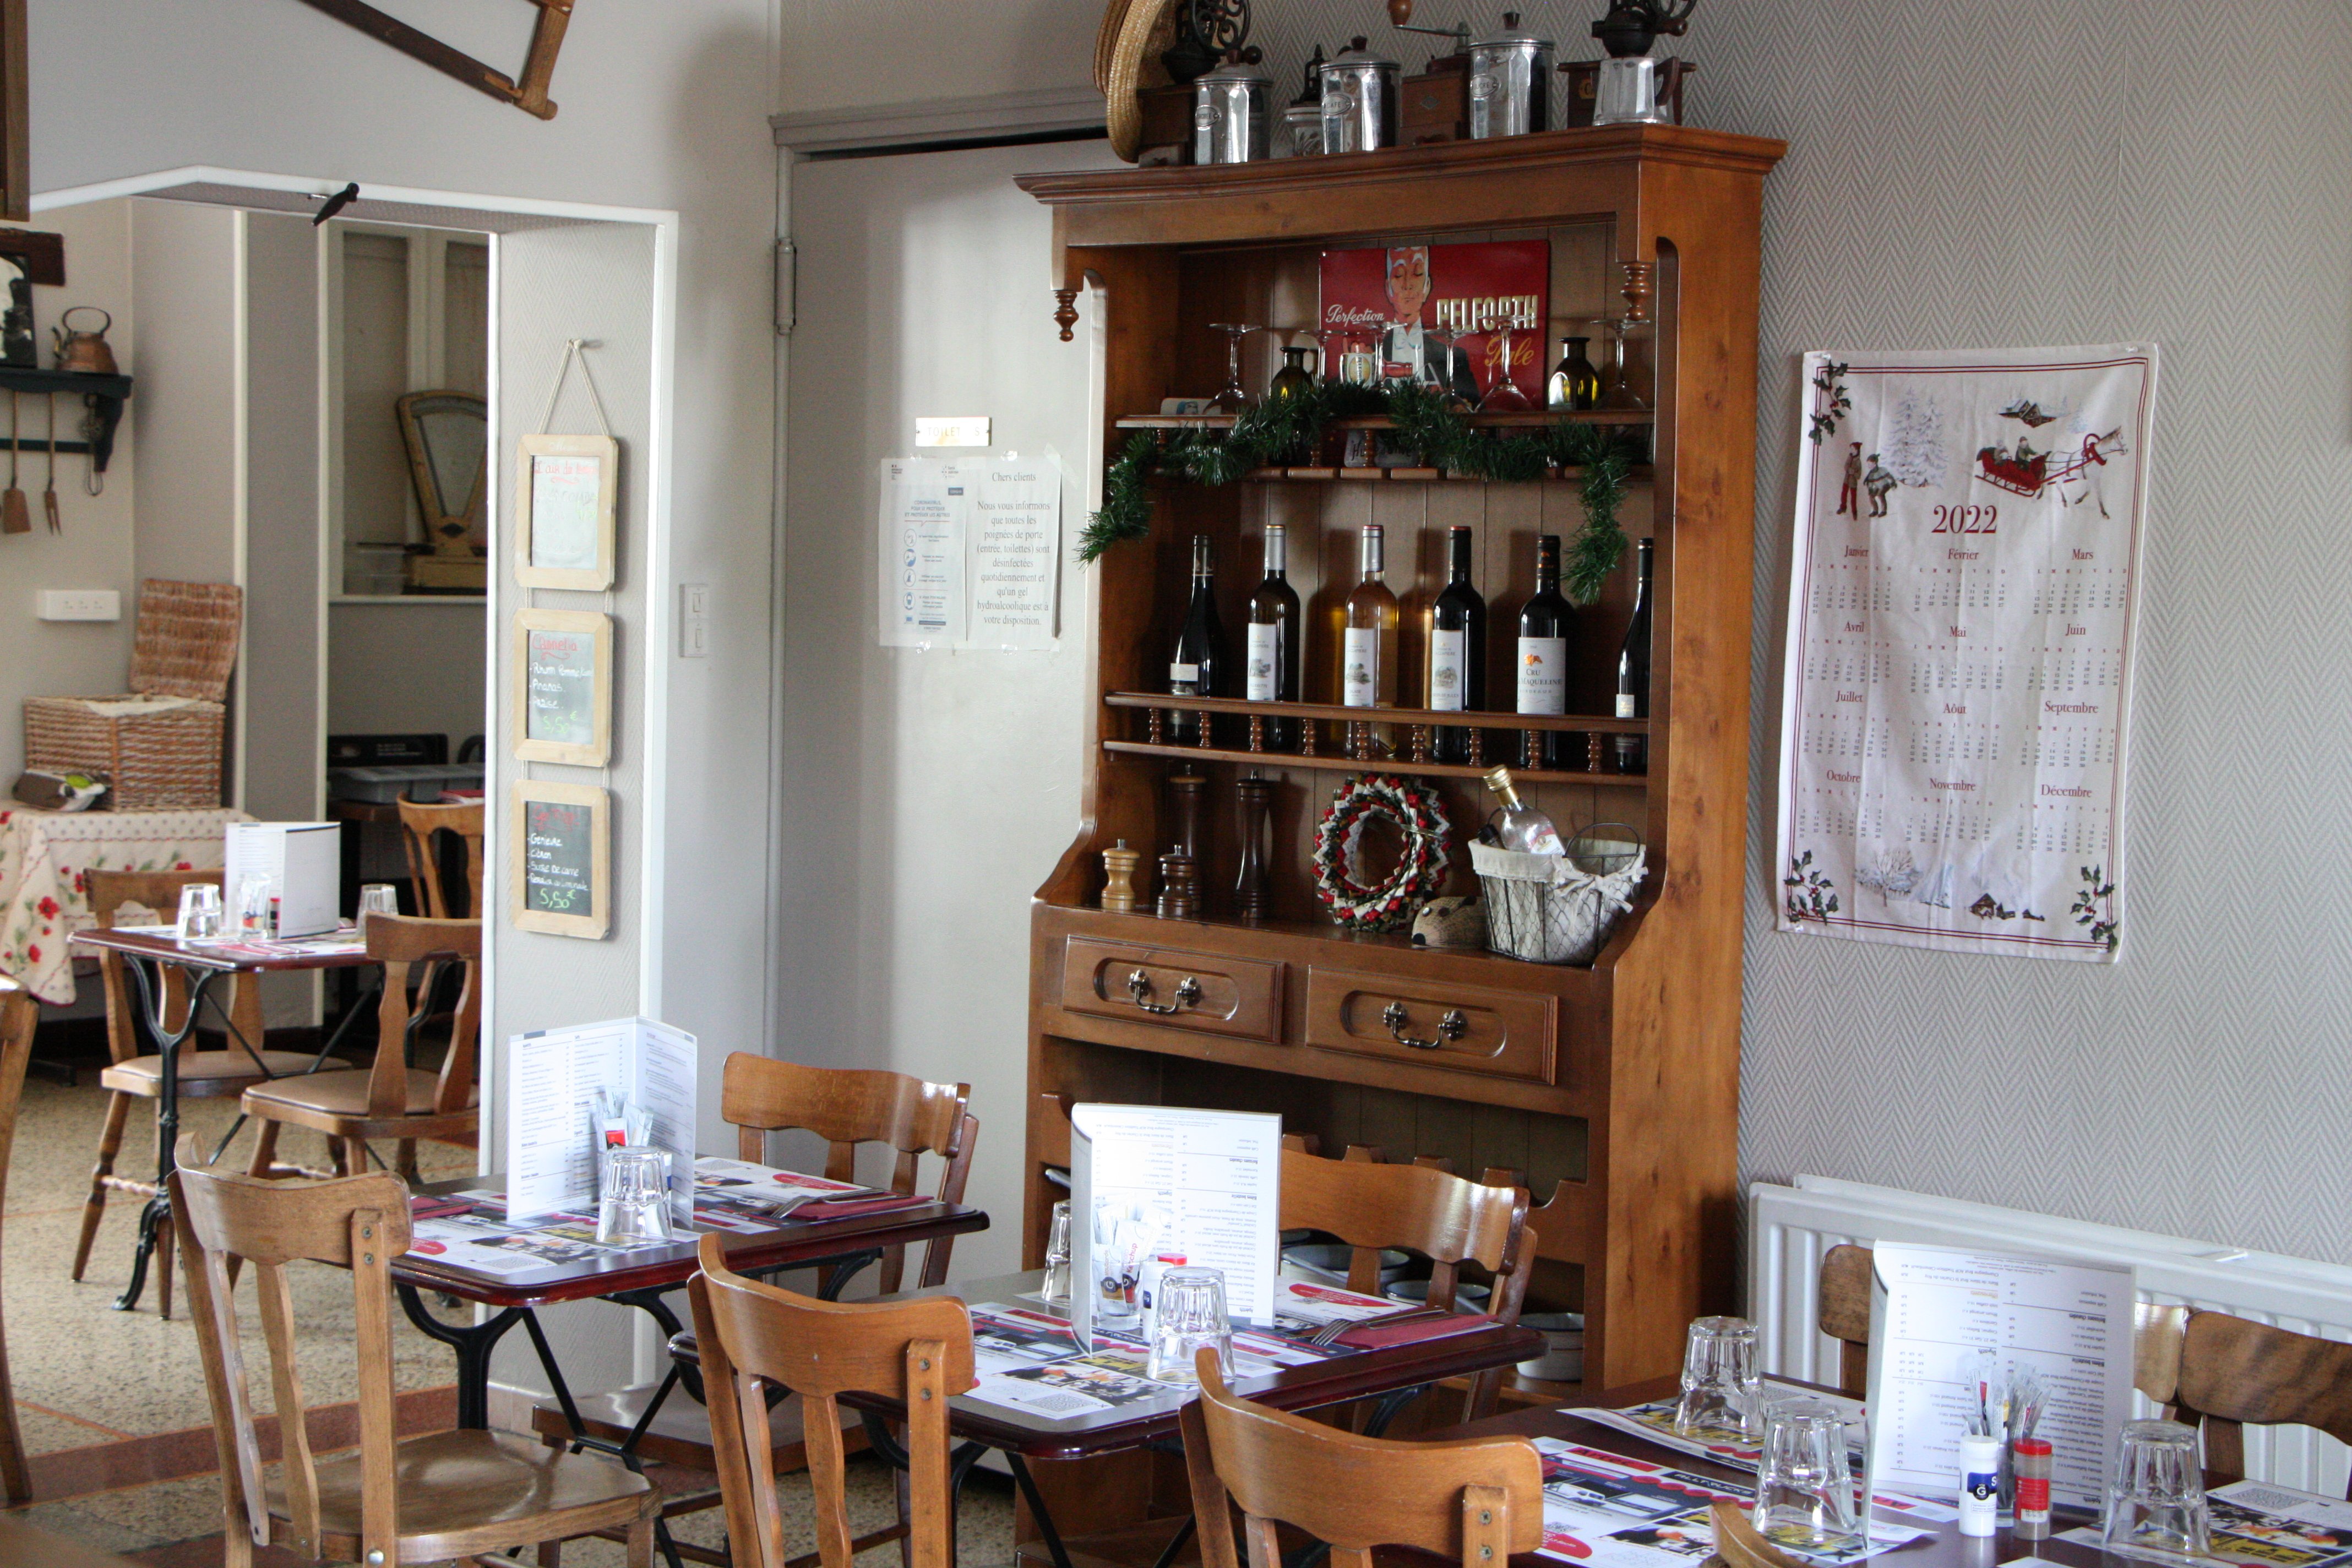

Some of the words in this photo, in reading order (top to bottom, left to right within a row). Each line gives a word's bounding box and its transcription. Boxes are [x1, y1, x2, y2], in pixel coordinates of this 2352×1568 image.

[1325, 303, 1385, 328] Perfection
[1436, 295, 1538, 330] PELFORTH
[927, 427, 980, 436] TOILETS
[992, 472, 1012, 481] Chers
[1014, 472, 1036, 481] clients
[977, 500, 995, 510] Nous
[1015, 500, 1050, 510] informons
[991, 517, 1004, 526] que
[1026, 515, 1036, 524] les
[1931, 504, 1997, 533] 2022
[984, 529, 1014, 541] poignées
[1015, 529, 1023, 538] de
[1025, 531, 1043, 541] porte
[1004, 543, 1033, 554] toilettes)
[1844, 545, 1869, 557] Janvier
[1948, 548, 1980, 560] Février
[2072, 548, 2094, 560] Mars
[992, 557, 1033, 567] désinfectées
[981, 572, 1037, 583] quotidiennement
[997, 586, 1016, 597] qu'un
[1017, 587, 1028, 598] gel
[977, 600, 1031, 613] hydroalcoolique
[1044, 602, 1049, 610] à
[983, 616, 1001, 624] votre
[1002, 615, 1042, 627] disposition.
[1844, 620, 1864, 633] Avril
[1950, 625, 1967, 638] Mai
[2065, 623, 2086, 636] Juin
[1836, 690, 1863, 703] Juillet
[2044, 700, 2099, 715] Septembre
[1826, 770, 1861, 784] Octobre
[1929, 777, 1976, 792] Novembre
[2040, 784, 2092, 798] Décembre
[1976, 1487, 1986, 1495] G
